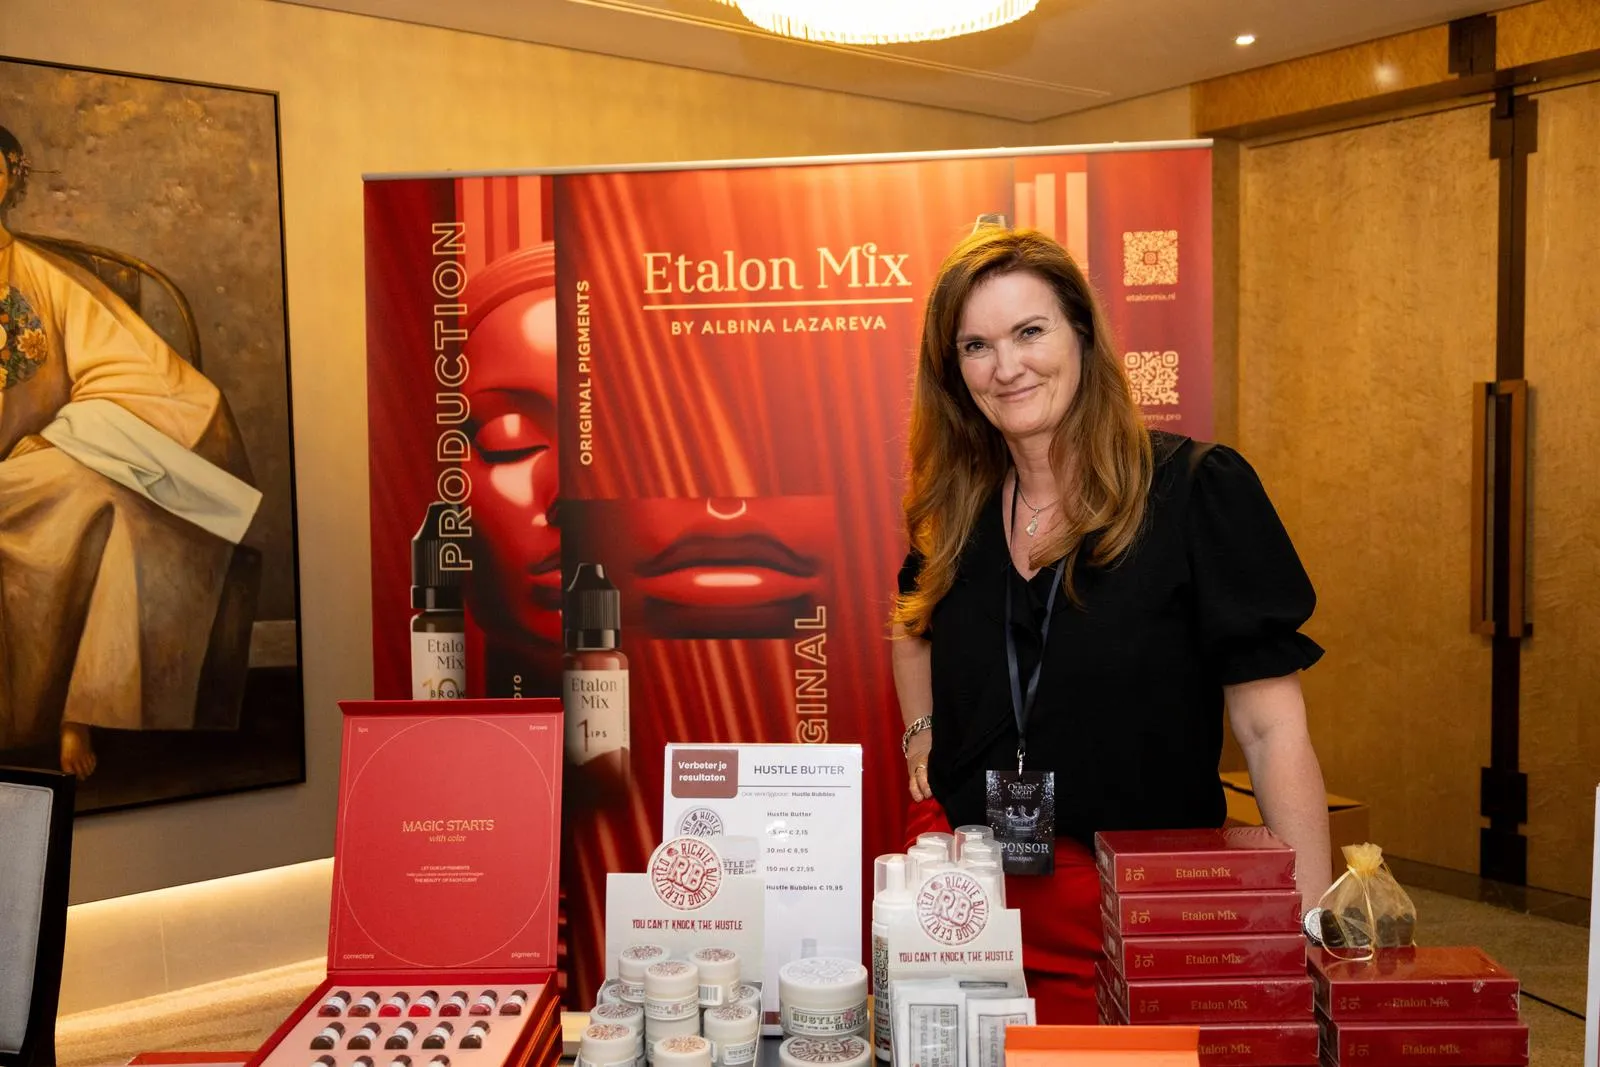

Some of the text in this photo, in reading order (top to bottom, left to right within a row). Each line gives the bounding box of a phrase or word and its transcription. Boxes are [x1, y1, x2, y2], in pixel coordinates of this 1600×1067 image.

[643, 242, 912, 294] Etalon Mix
[671, 315, 887, 335] BY ALBINA LAZAREVA
[577, 280, 593, 466] ORIGINAL PIGMENTS
[432, 222, 473, 571] PRODUCTION
[437, 656, 465, 670] Mix
[794, 605, 828, 744] GINAL
[571, 677, 618, 693] Etalon
[581, 695, 610, 710] Mix
[678, 761, 728, 773] Verbeter je
[753, 764, 845, 775] HUSTLE BUTTER
[679, 773, 726, 782] resultaten
[402, 819, 495, 832] MAGIC STARTS
[429, 834, 467, 842] with color
[681, 842, 714, 865] RICHIE
[1000, 842, 1049, 854] PONSOR
[1134, 866, 1145, 881] 16
[1176, 866, 1231, 879] Etalon Mix
[944, 876, 981, 898] RICHIE
[1182, 909, 1237, 921] Etalon Mix
[632, 919, 743, 932] YOU CAN'T KNOCK THE HUSTLE
[899, 950, 1014, 965] YOU CAN'T KNOCK THE HUSTLE
[1185, 952, 1241, 965] Etalon Mix
[1191, 999, 1248, 1010] Etalon Mix
